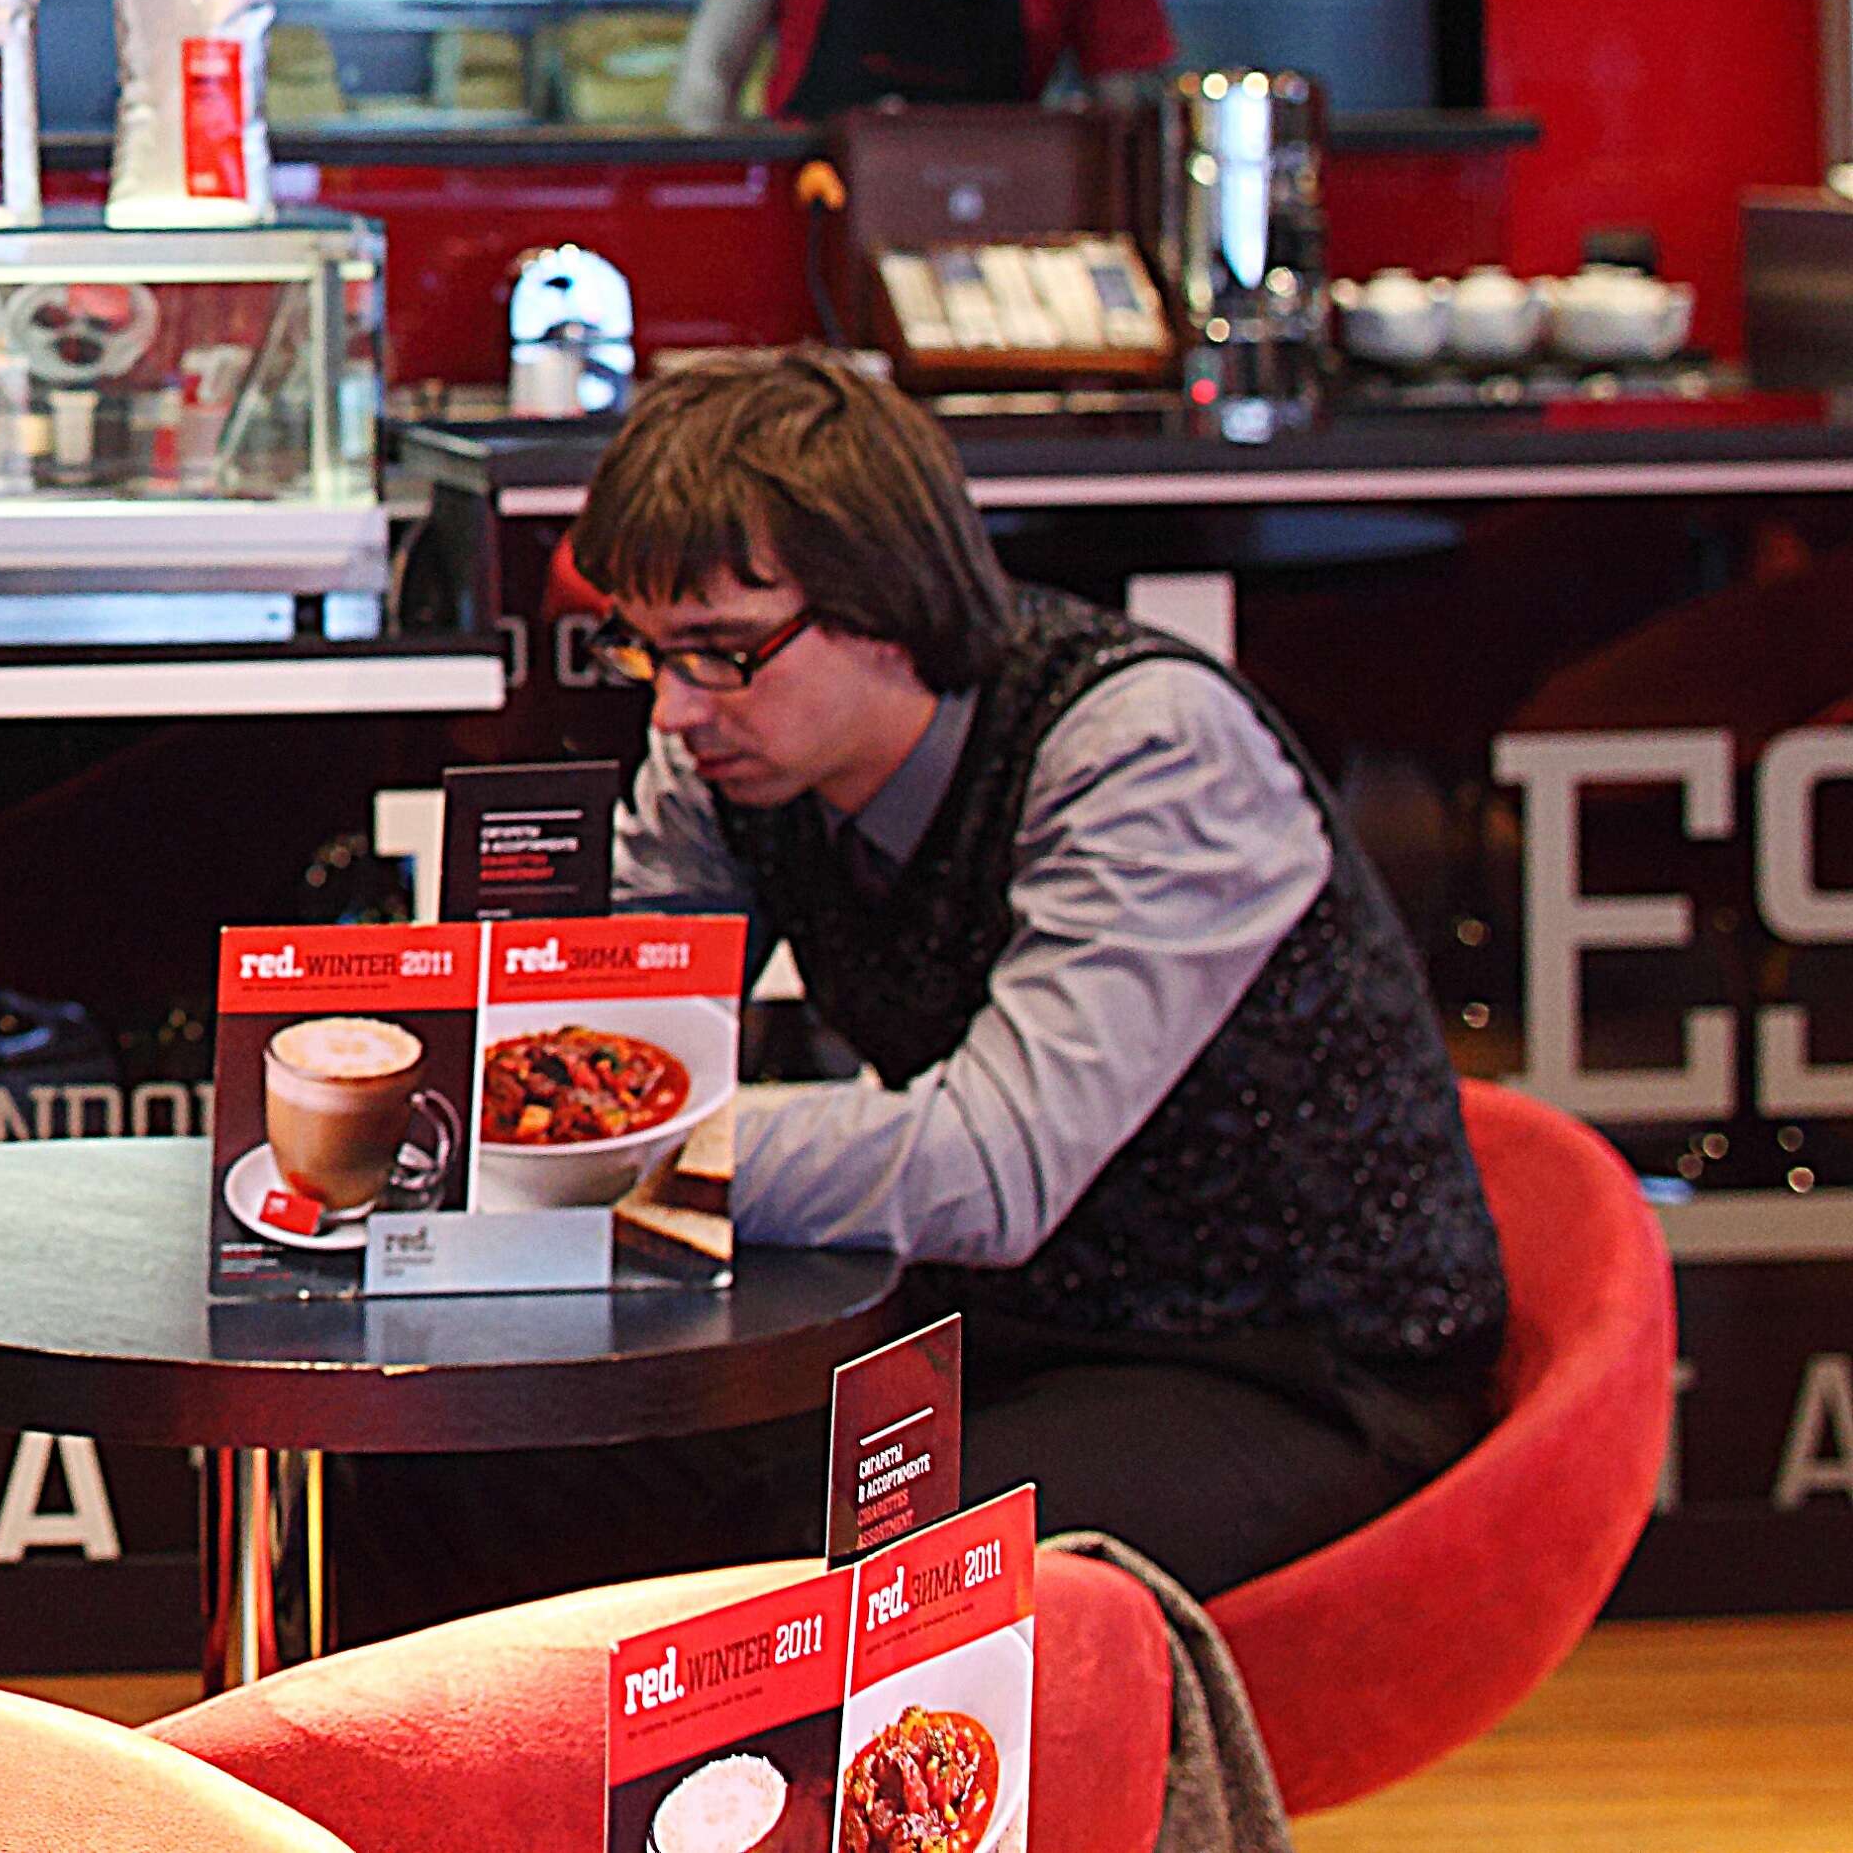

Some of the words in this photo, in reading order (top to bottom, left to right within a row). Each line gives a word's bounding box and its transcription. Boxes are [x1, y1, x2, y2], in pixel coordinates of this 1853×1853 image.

[240, 945, 304, 979] red.
[306, 954, 396, 977] WINTER
[400, 950, 453, 976] 2011
[504, 938, 567, 974] red.
[570, 945, 633, 971] ЗИМА
[636, 942, 691, 970] 2011
[383, 1226, 435, 1254] red.
[865, 1565, 909, 1632] red.
[912, 1567, 962, 1611] ЗИМА
[964, 1538, 1003, 1587] 2011
[624, 1647, 685, 1716] red.
[687, 1633, 772, 1693] WINTER
[774, 1614, 823, 1664] 2011
